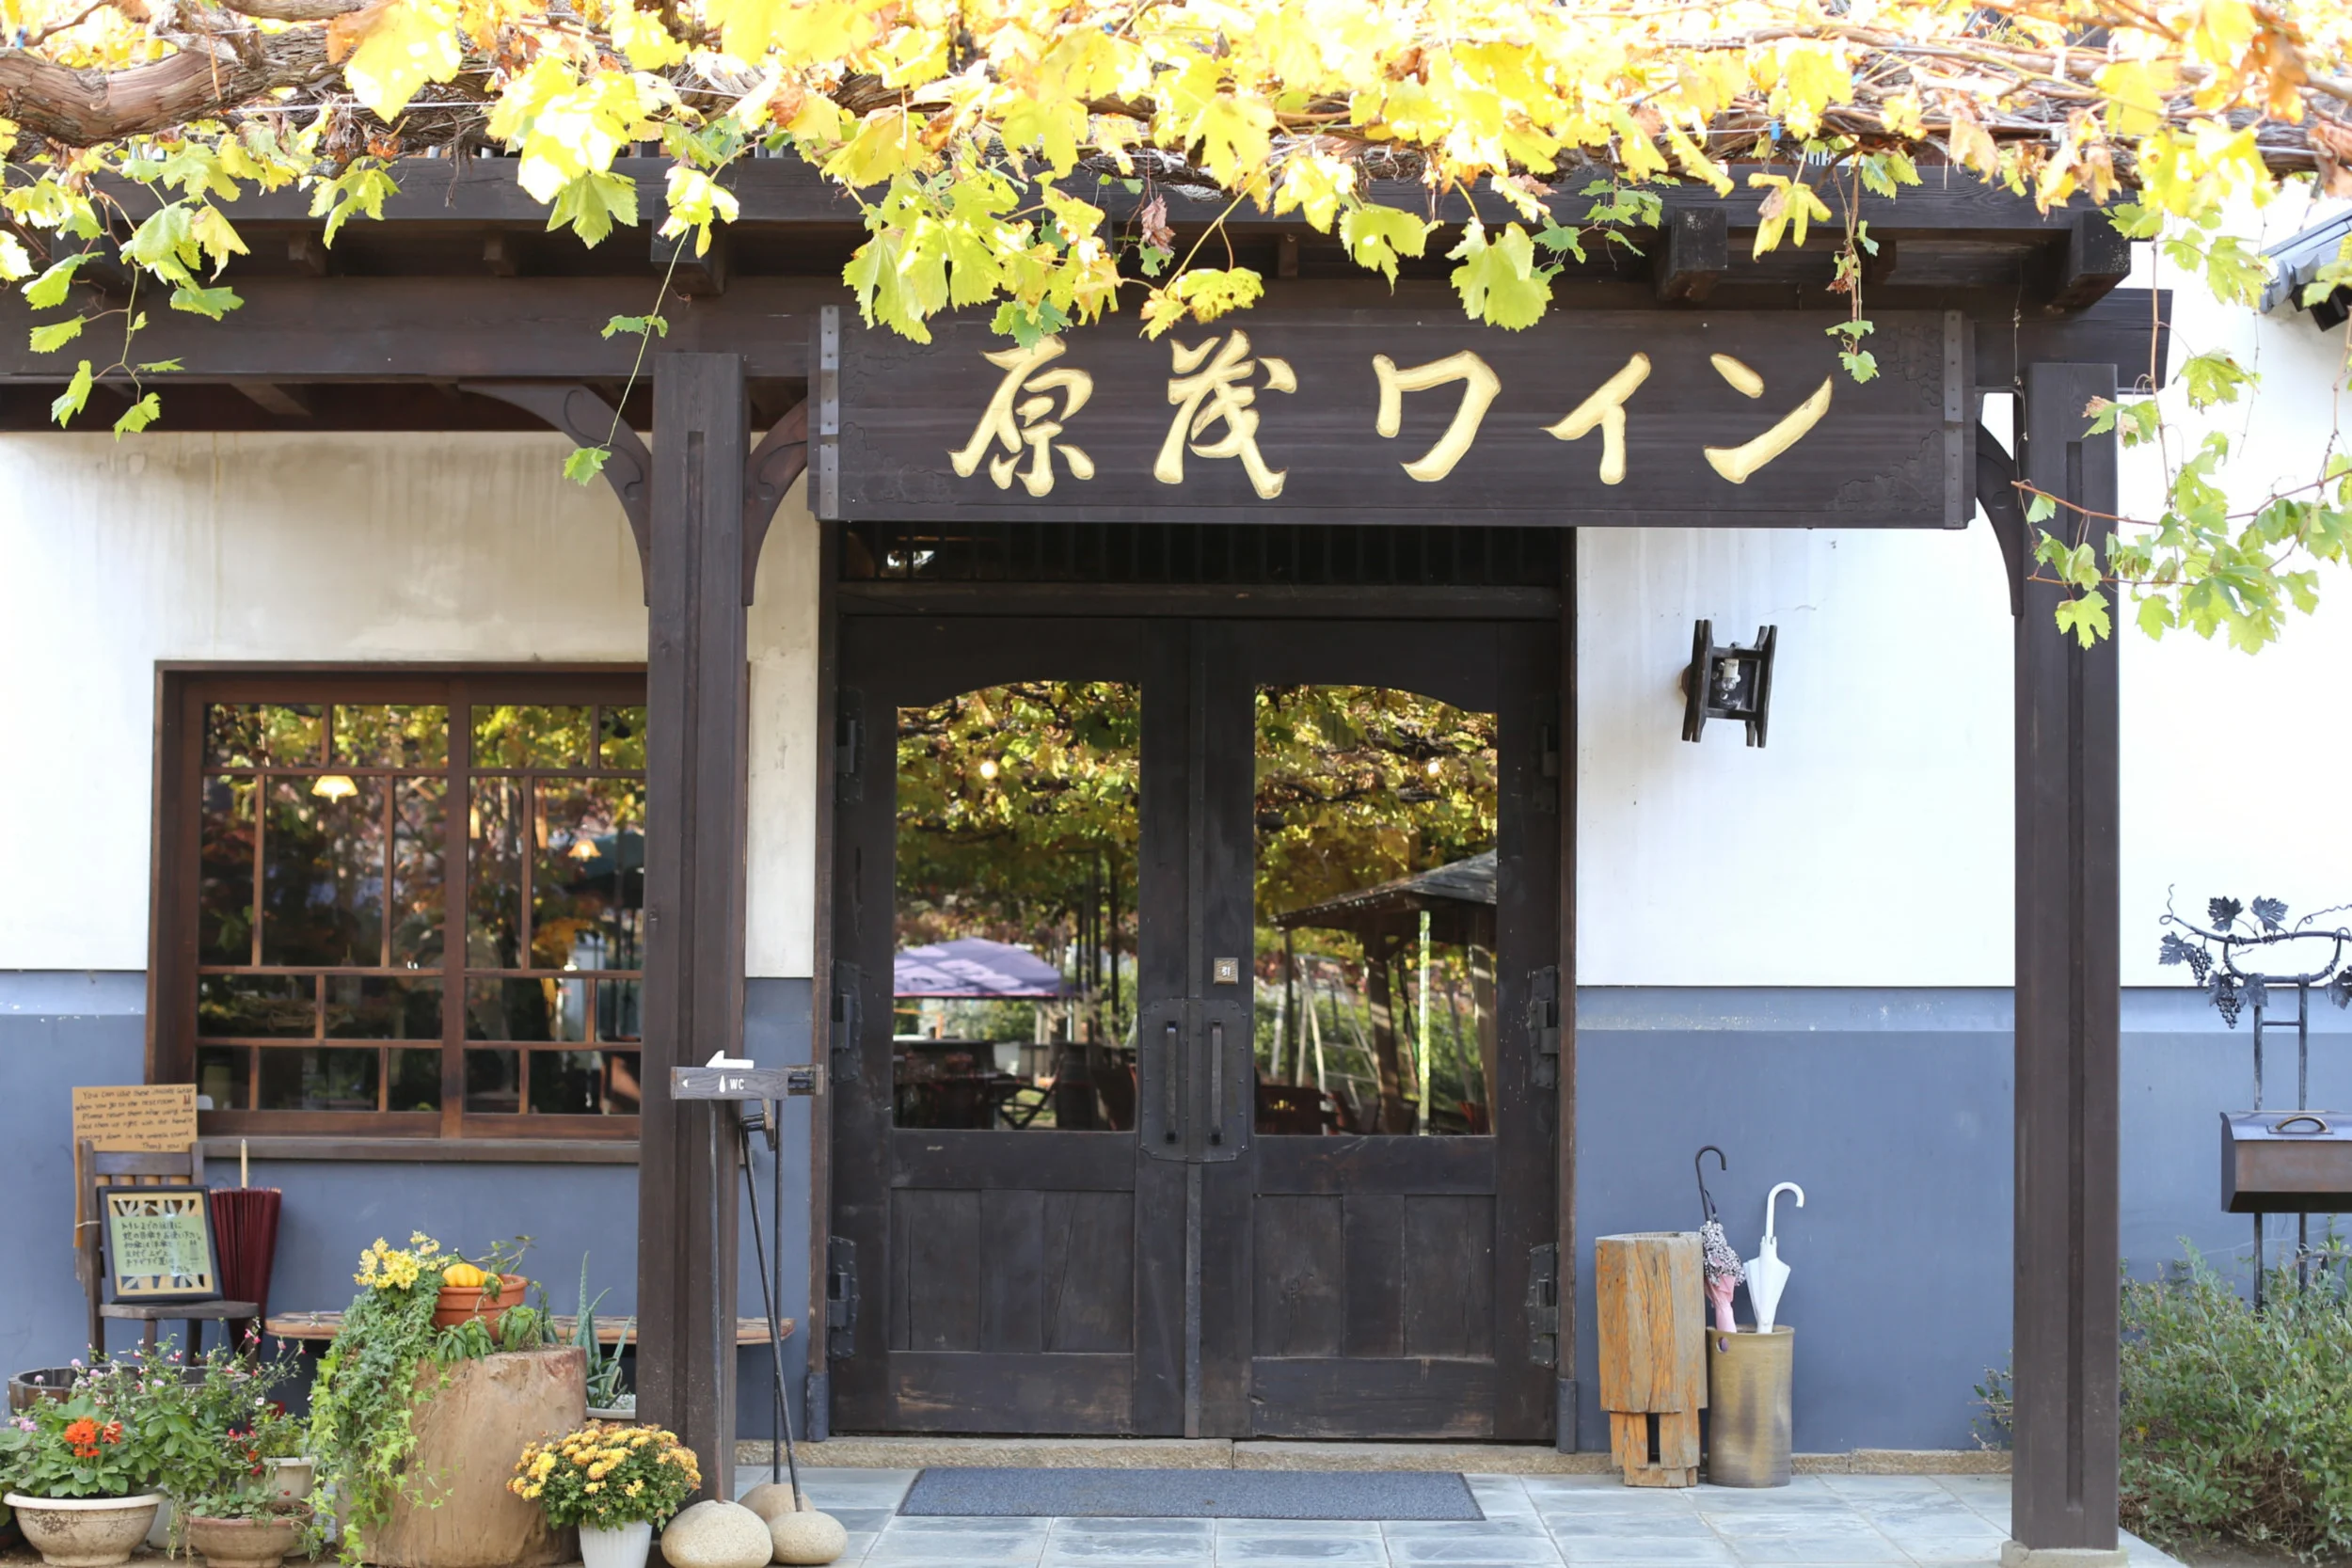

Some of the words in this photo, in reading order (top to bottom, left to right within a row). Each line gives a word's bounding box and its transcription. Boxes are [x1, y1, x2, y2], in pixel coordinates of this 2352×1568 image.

[947, 327, 1834, 499] 原茂ワイン
[729, 1078, 745, 1090] WC
[82, 1091, 98, 1100] You
